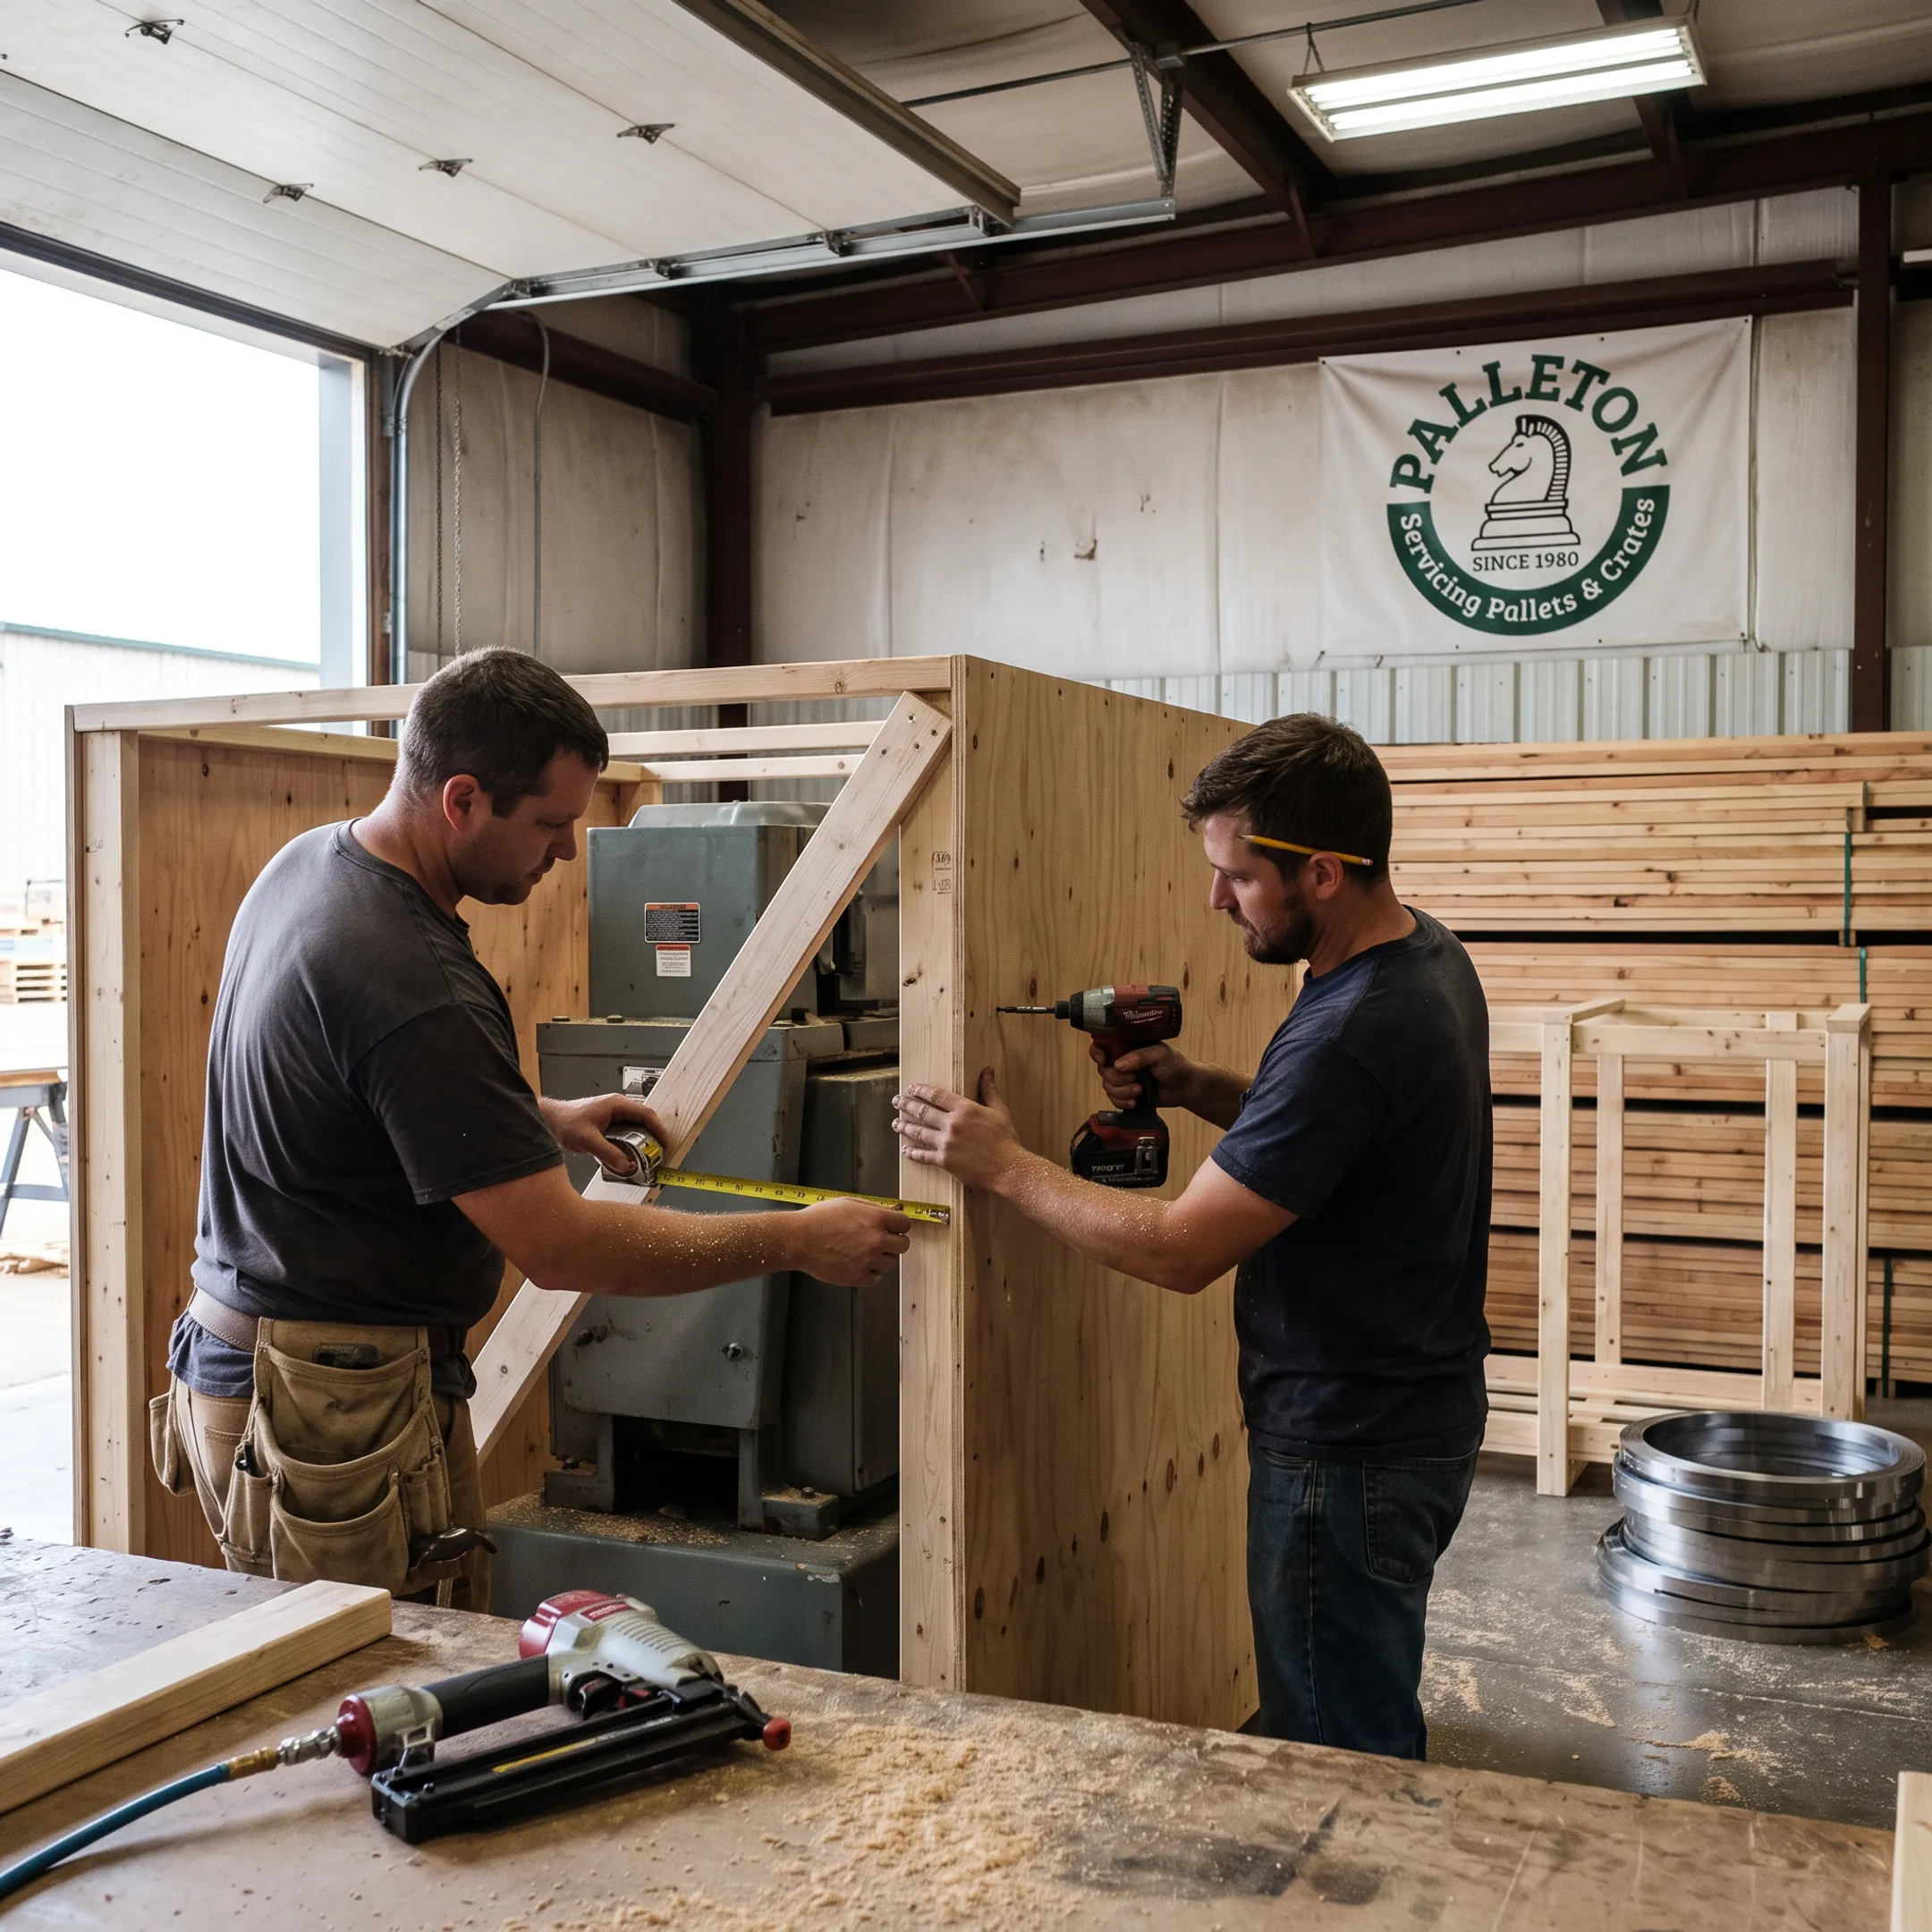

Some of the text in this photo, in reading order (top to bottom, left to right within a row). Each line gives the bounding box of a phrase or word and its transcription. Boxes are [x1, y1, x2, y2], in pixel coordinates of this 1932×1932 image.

[1389, 354, 1668, 494] PALLETON
[1401, 497, 1655, 622] Servicing Pallets & Crates
[1472, 551, 1579, 572] SINCE 1980
